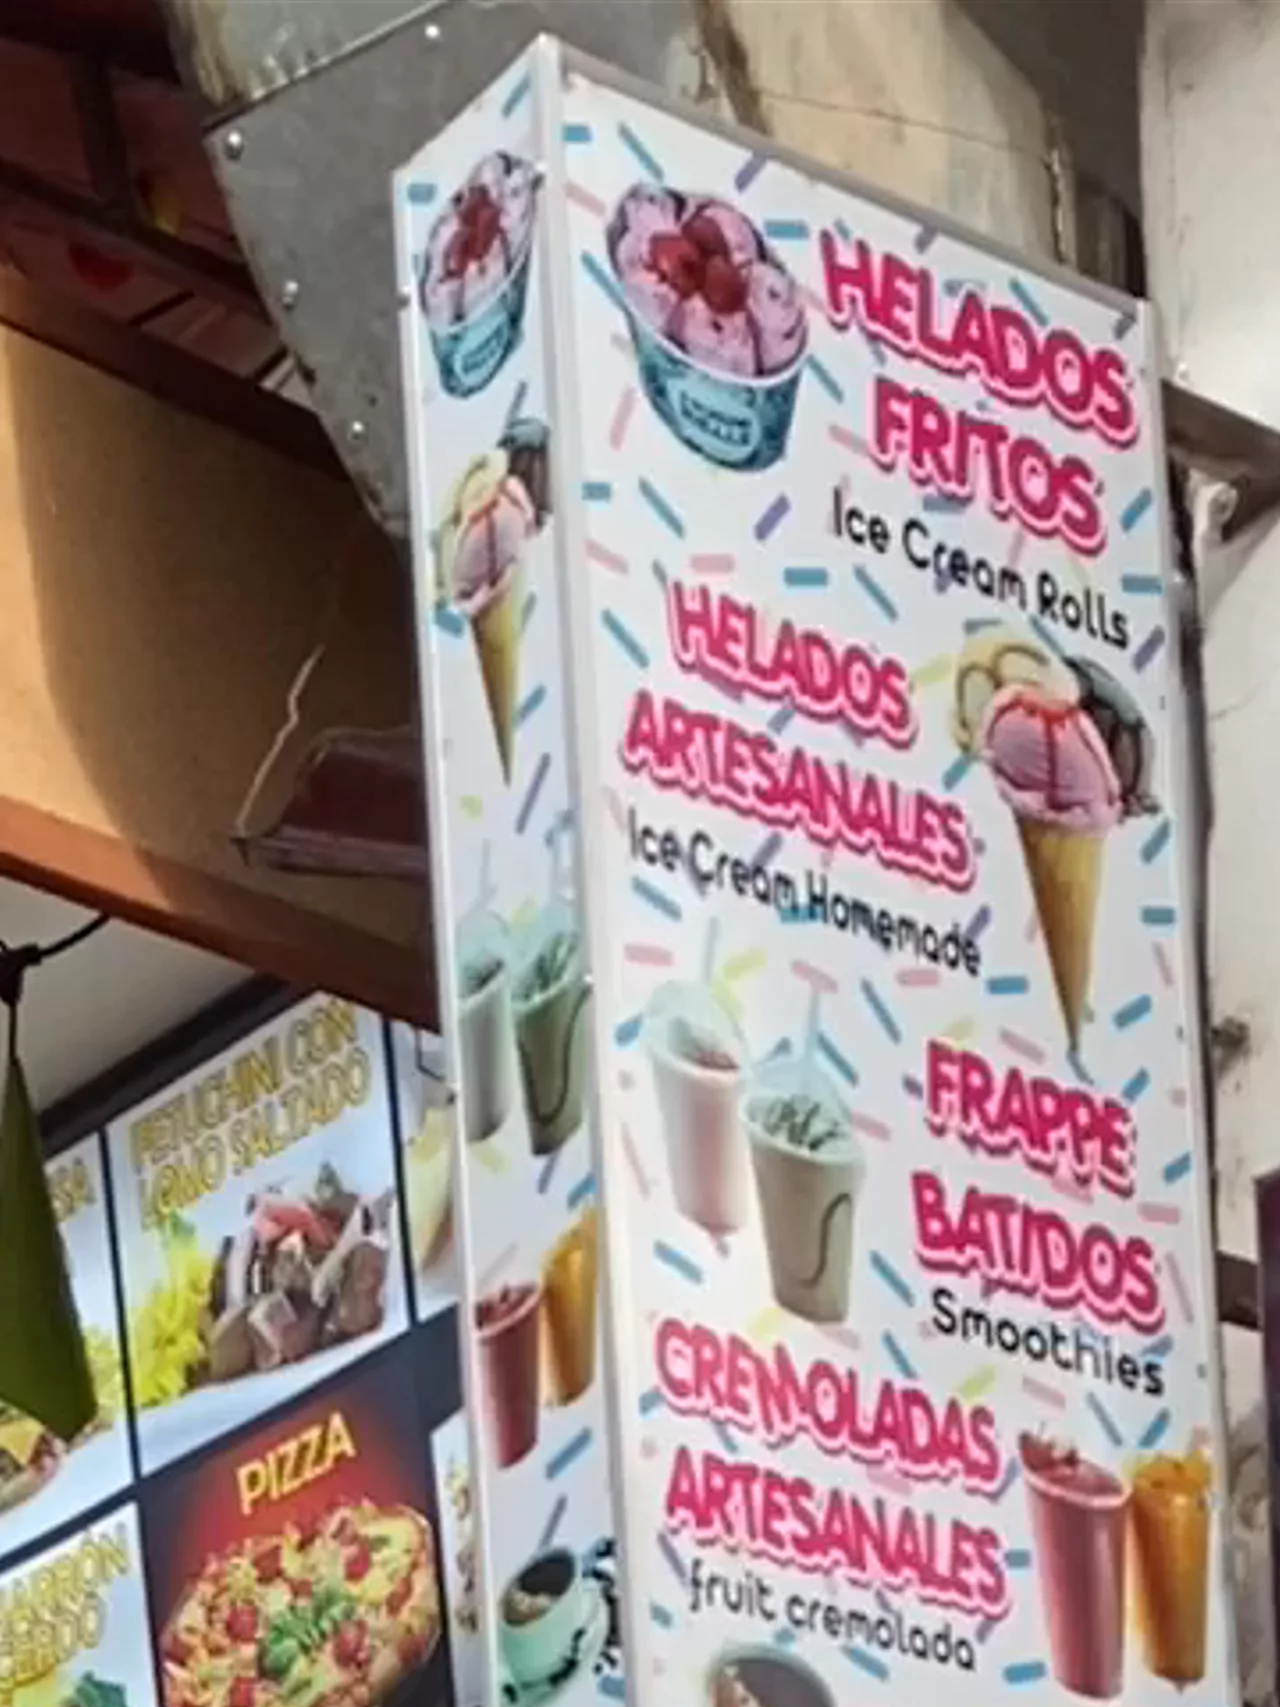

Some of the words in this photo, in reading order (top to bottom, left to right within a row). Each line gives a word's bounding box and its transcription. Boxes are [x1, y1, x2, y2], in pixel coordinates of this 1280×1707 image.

[819, 227, 1137, 445] HELADOS
[872, 382, 1106, 550] FRITOS
[832, 487, 890, 551] Ice
[904, 519, 1025, 606] Cream
[1038, 568, 1132, 651] Rolls
[664, 579, 918, 747] HELADOS
[619, 689, 975, 892] ARTESANALES
[629, 807, 680, 869] Ice
[688, 829, 799, 913] Cream
[806, 867, 983, 978] Homemade
[924, 1038, 1134, 1186] FRAPPE
[911, 1174, 1163, 1332] BATIDOS
[653, 1317, 1005, 1492] CREMOLADAS
[932, 1287, 1166, 1398] Smoothies
[237, 1414, 359, 1517] PIZZA
[661, 1446, 1008, 1618] ARTESANALES
[687, 1562, 773, 1626] fruit
[786, 1592, 978, 1675] cremolada
